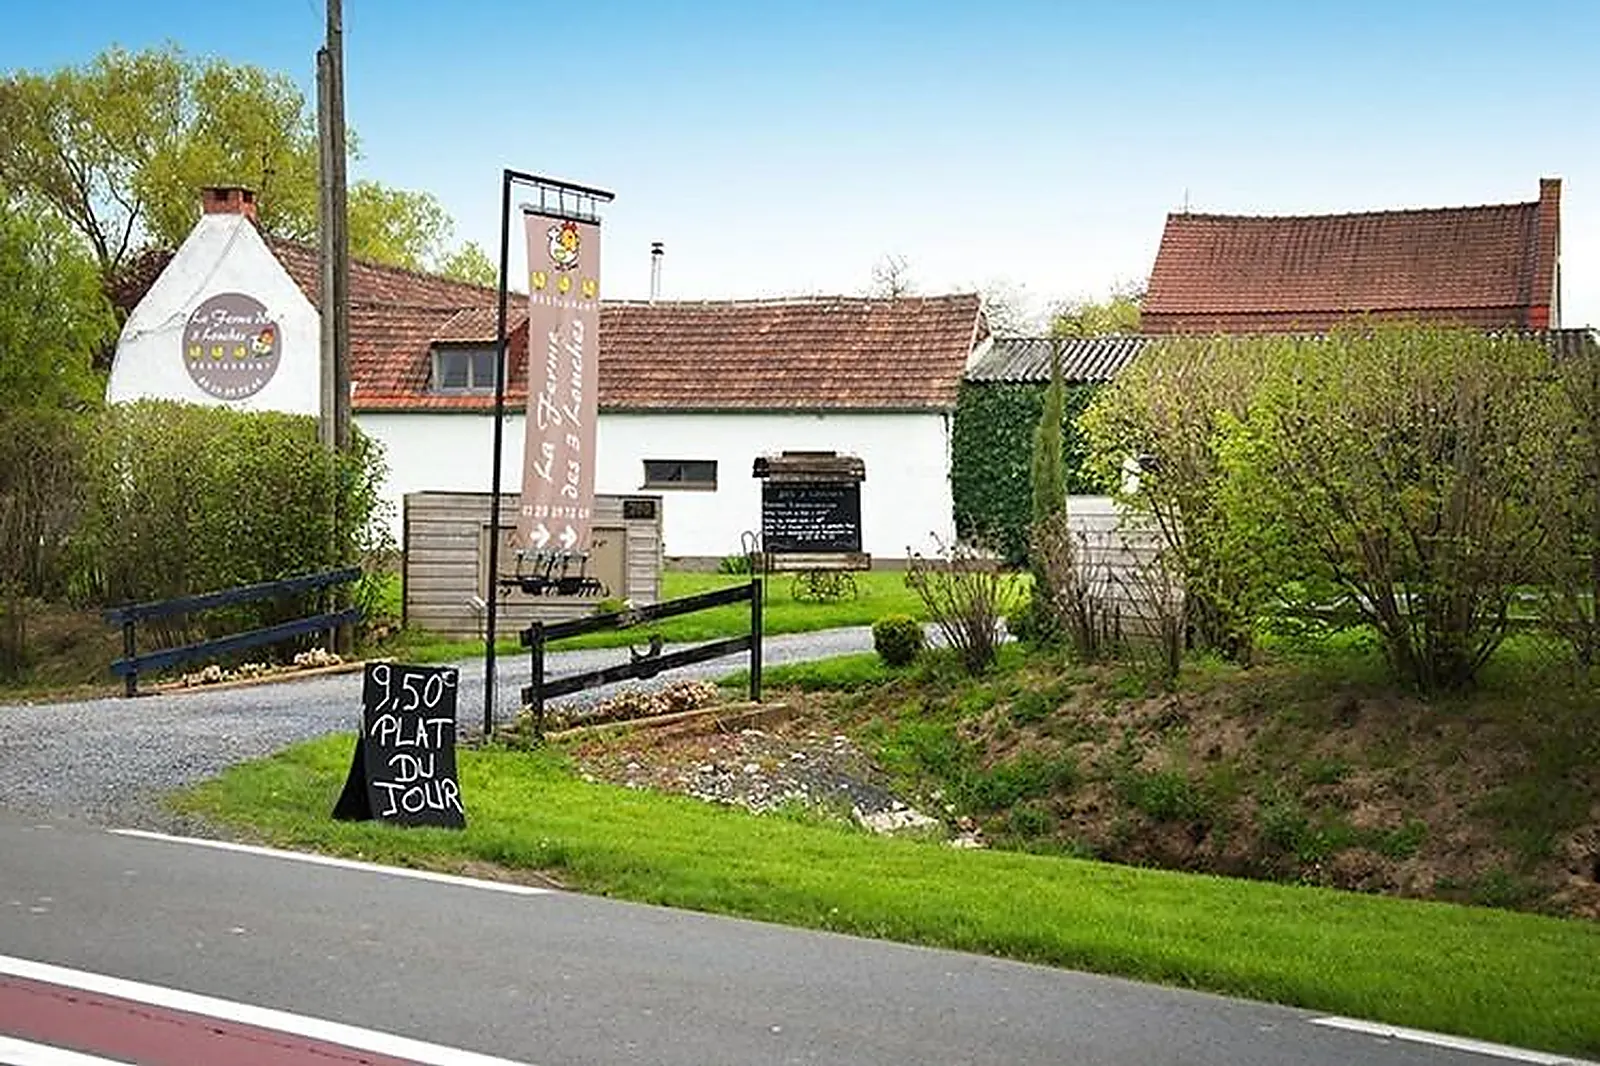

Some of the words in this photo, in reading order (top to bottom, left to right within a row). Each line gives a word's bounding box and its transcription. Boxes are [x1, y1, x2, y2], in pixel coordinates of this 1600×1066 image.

[210, 308, 252, 328] Ferme
[537, 331, 562, 430] Ferme
[566, 433, 580, 452] 3
[533, 441, 555, 483] La
[561, 459, 581, 499] des
[370, 713, 454, 749] PLAT
[388, 752, 435, 783] DU
[373, 778, 464, 816] JOUR
